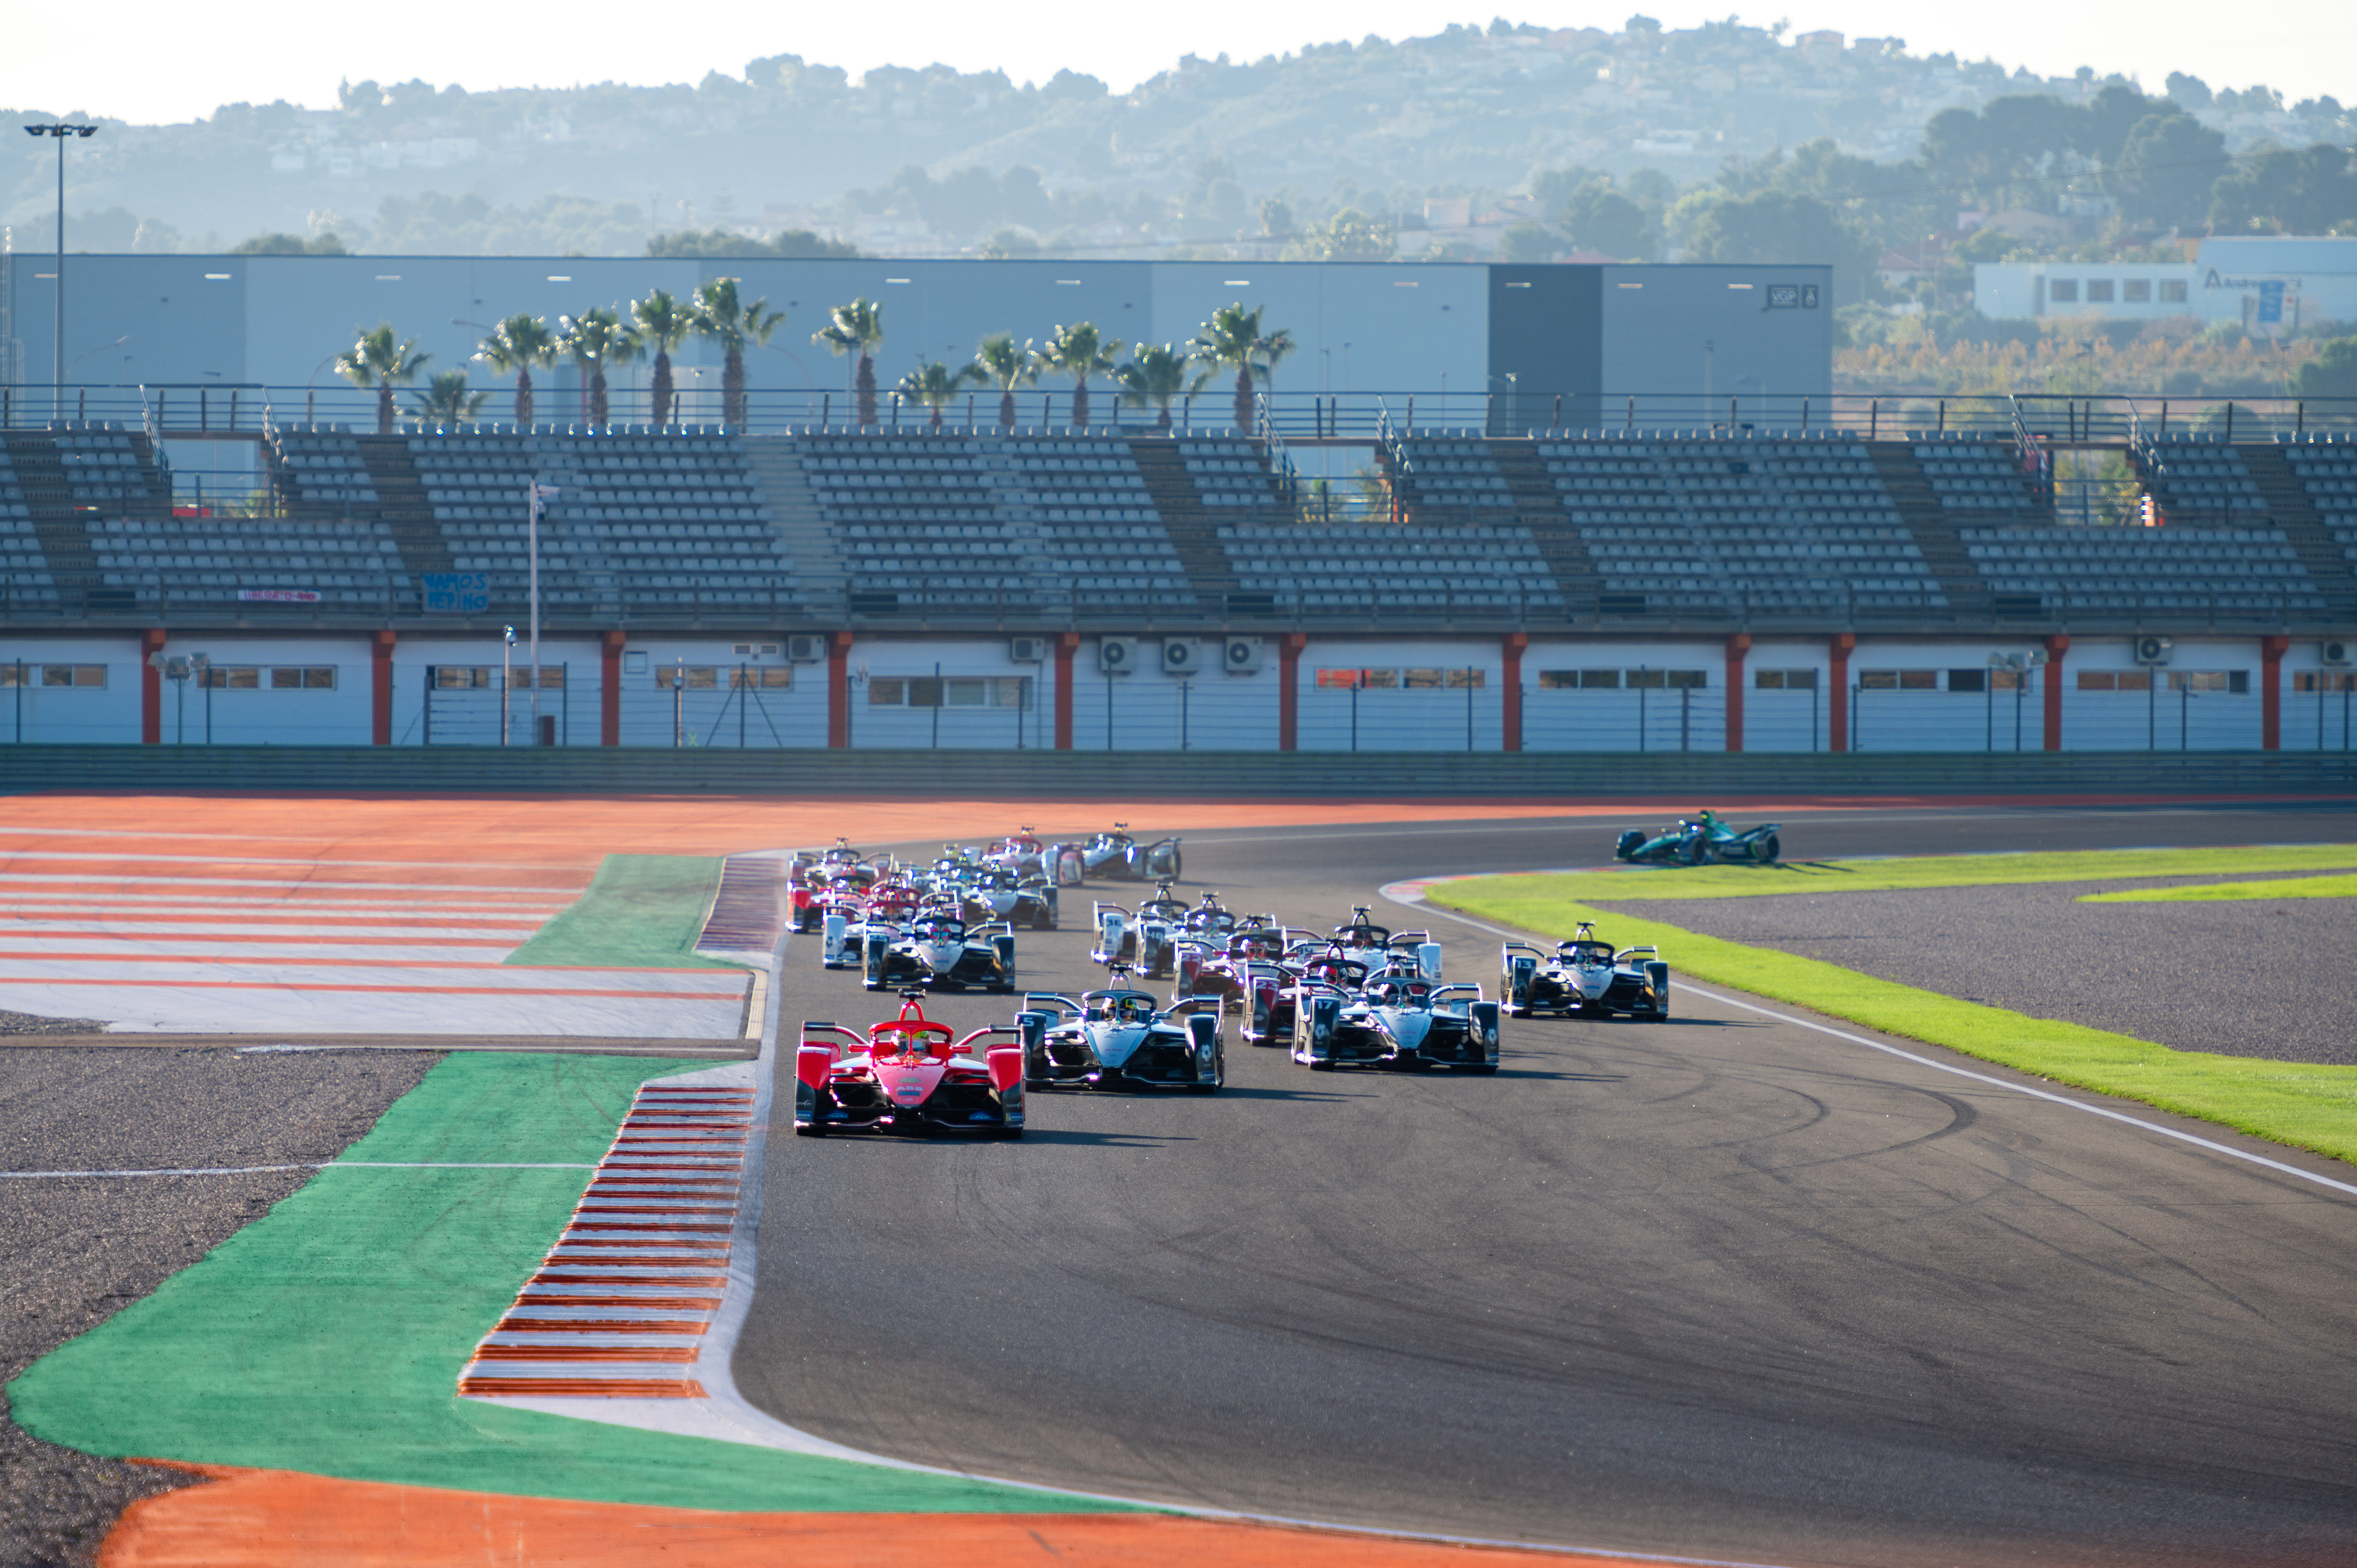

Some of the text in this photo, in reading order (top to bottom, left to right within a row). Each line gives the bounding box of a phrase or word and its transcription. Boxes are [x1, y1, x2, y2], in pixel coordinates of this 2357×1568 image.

[421, 573, 486, 591] VAMOS
[1516, 960, 1531, 969] 13
[1256, 980, 1279, 992] 23
[1316, 1000, 1333, 1009] 17
[1023, 1017, 1034, 1027] 5
